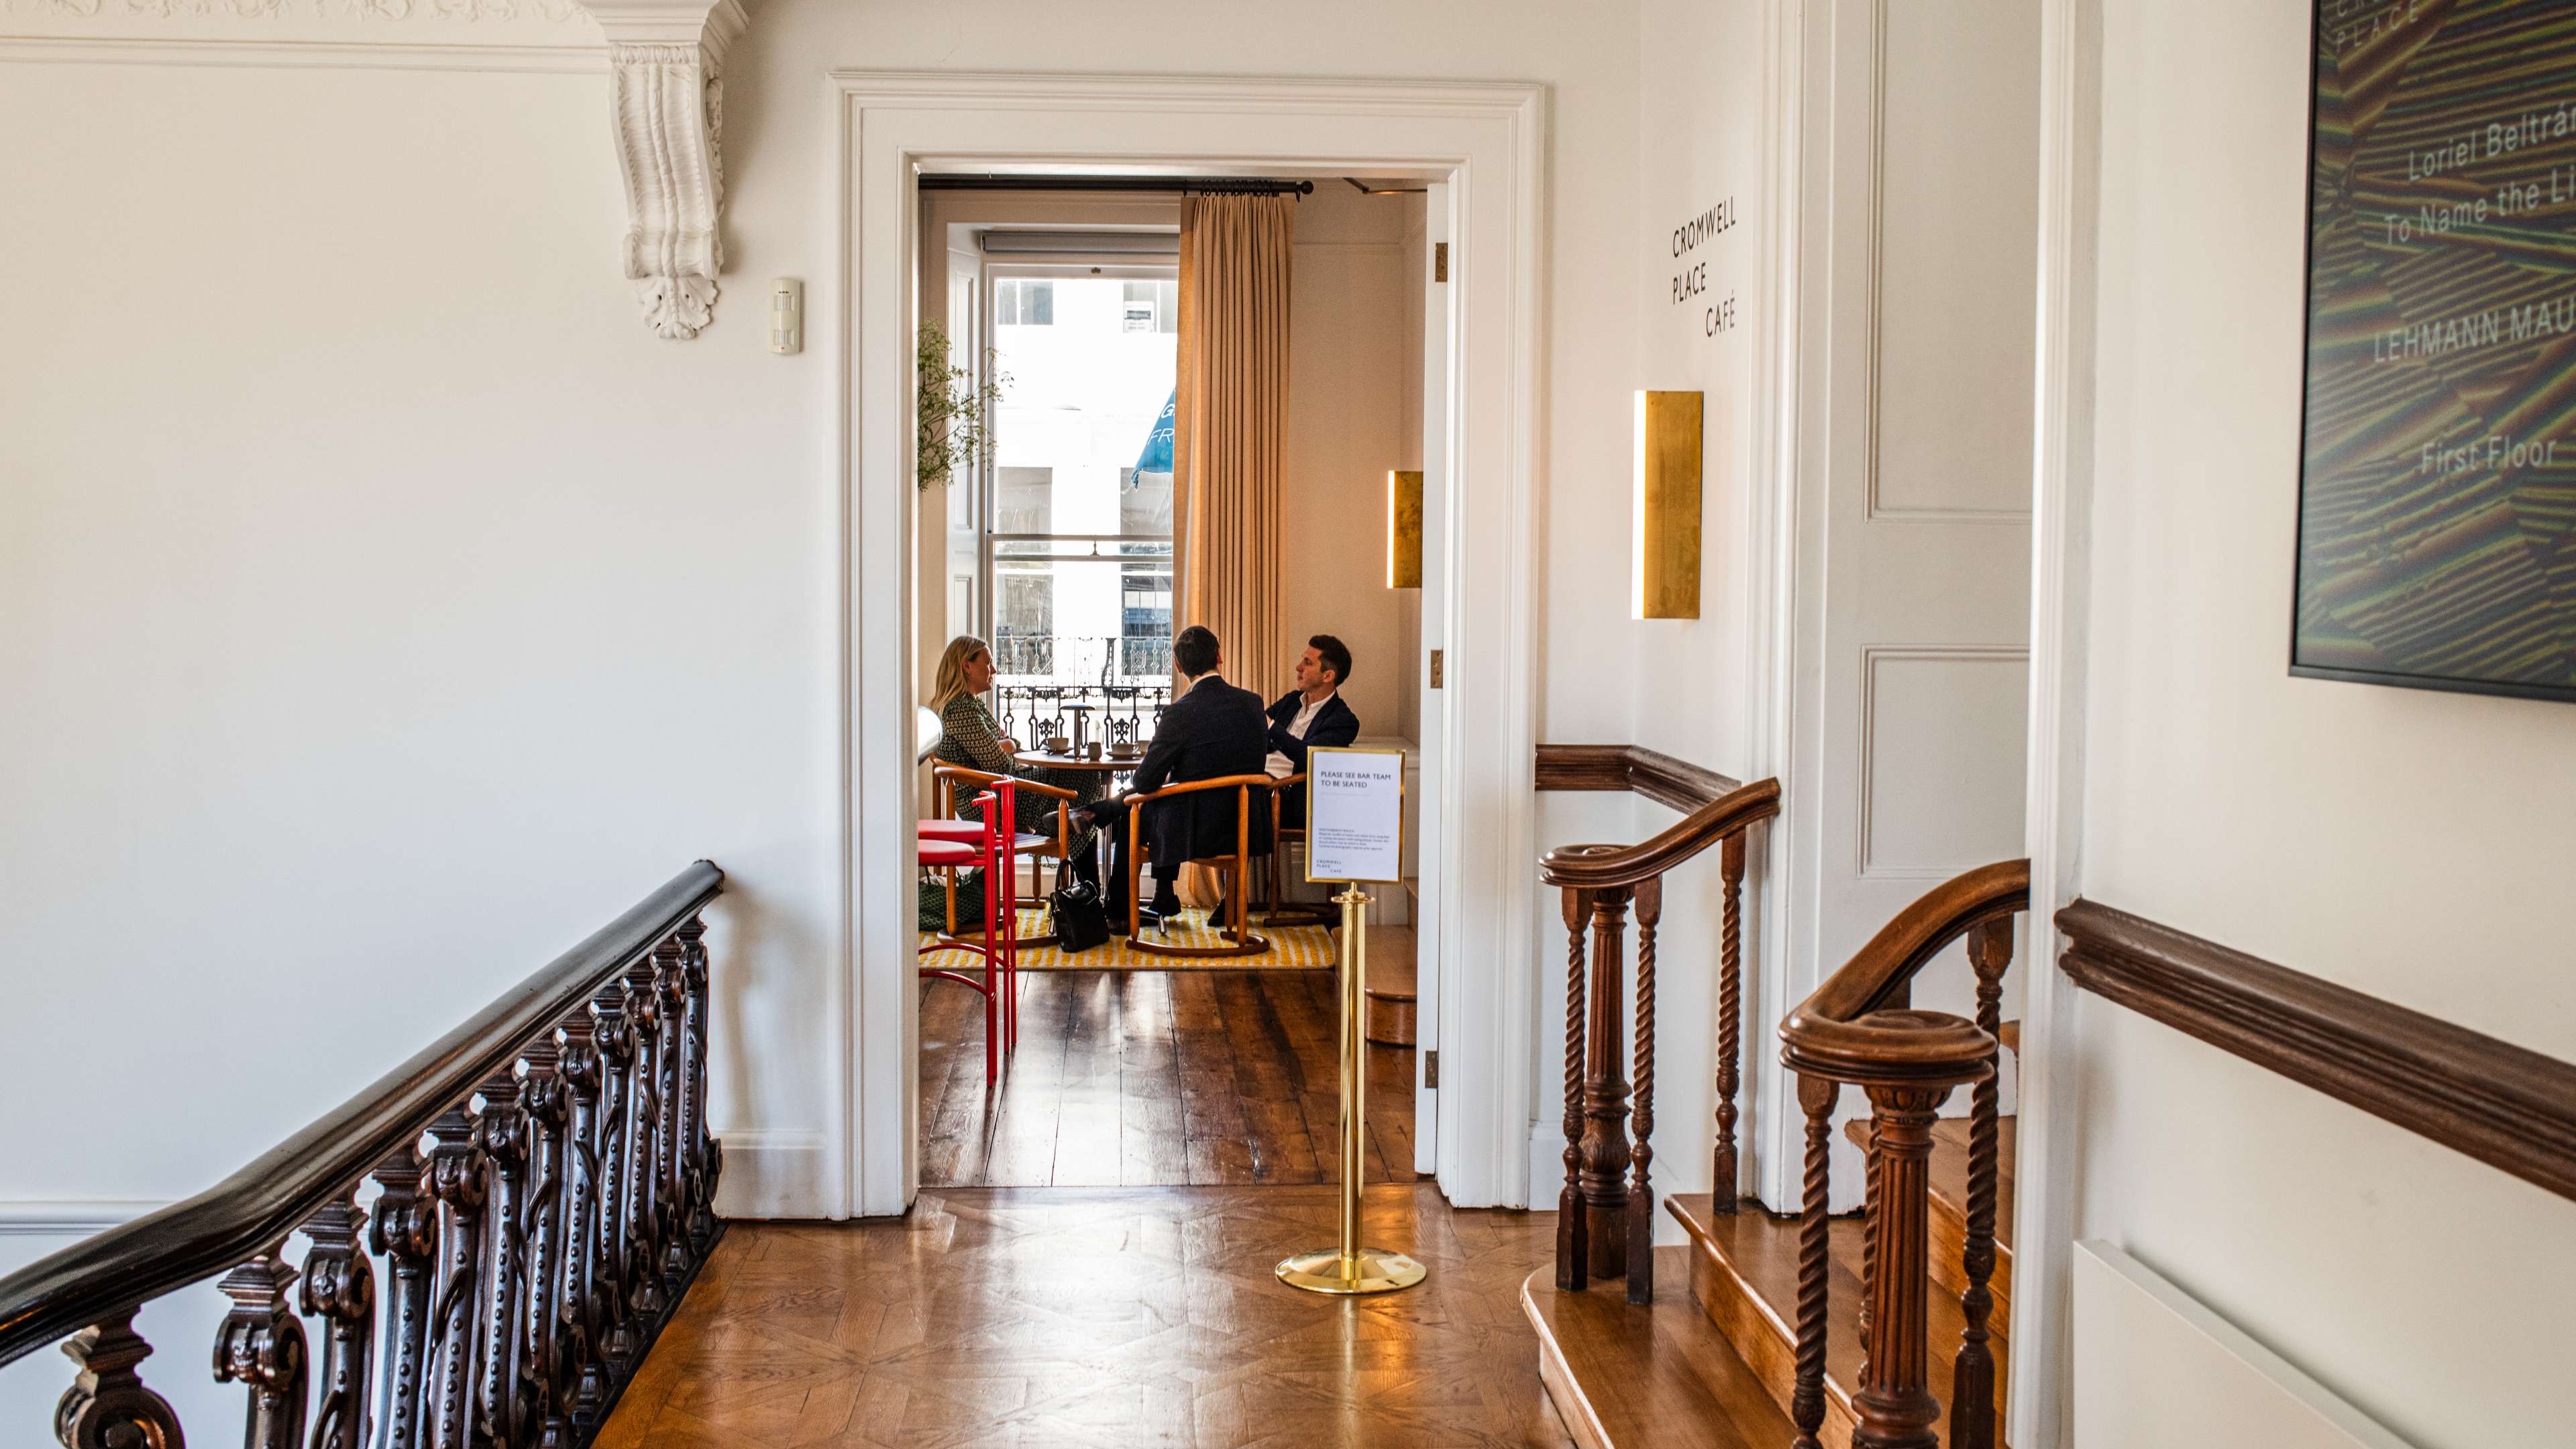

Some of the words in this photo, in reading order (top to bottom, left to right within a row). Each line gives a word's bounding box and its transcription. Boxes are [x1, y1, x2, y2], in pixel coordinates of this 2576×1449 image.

[2337, 0, 2419, 53] PLACE
[2409, 130, 2476, 181] Loriel
[1673, 195, 1736, 258] CROMWELL
[2384, 214, 2411, 246] To
[2420, 197, 2487, 236] Name
[2497, 180, 2540, 216] the
[1672, 262, 1706, 305] PLACE
[1705, 289, 1735, 337] CAFÉ
[2374, 310, 2499, 363] LEHMANN
[2421, 439, 2481, 474] First
[2487, 435, 2557, 470] Floor
[1321, 771, 1342, 779] PLEASE
